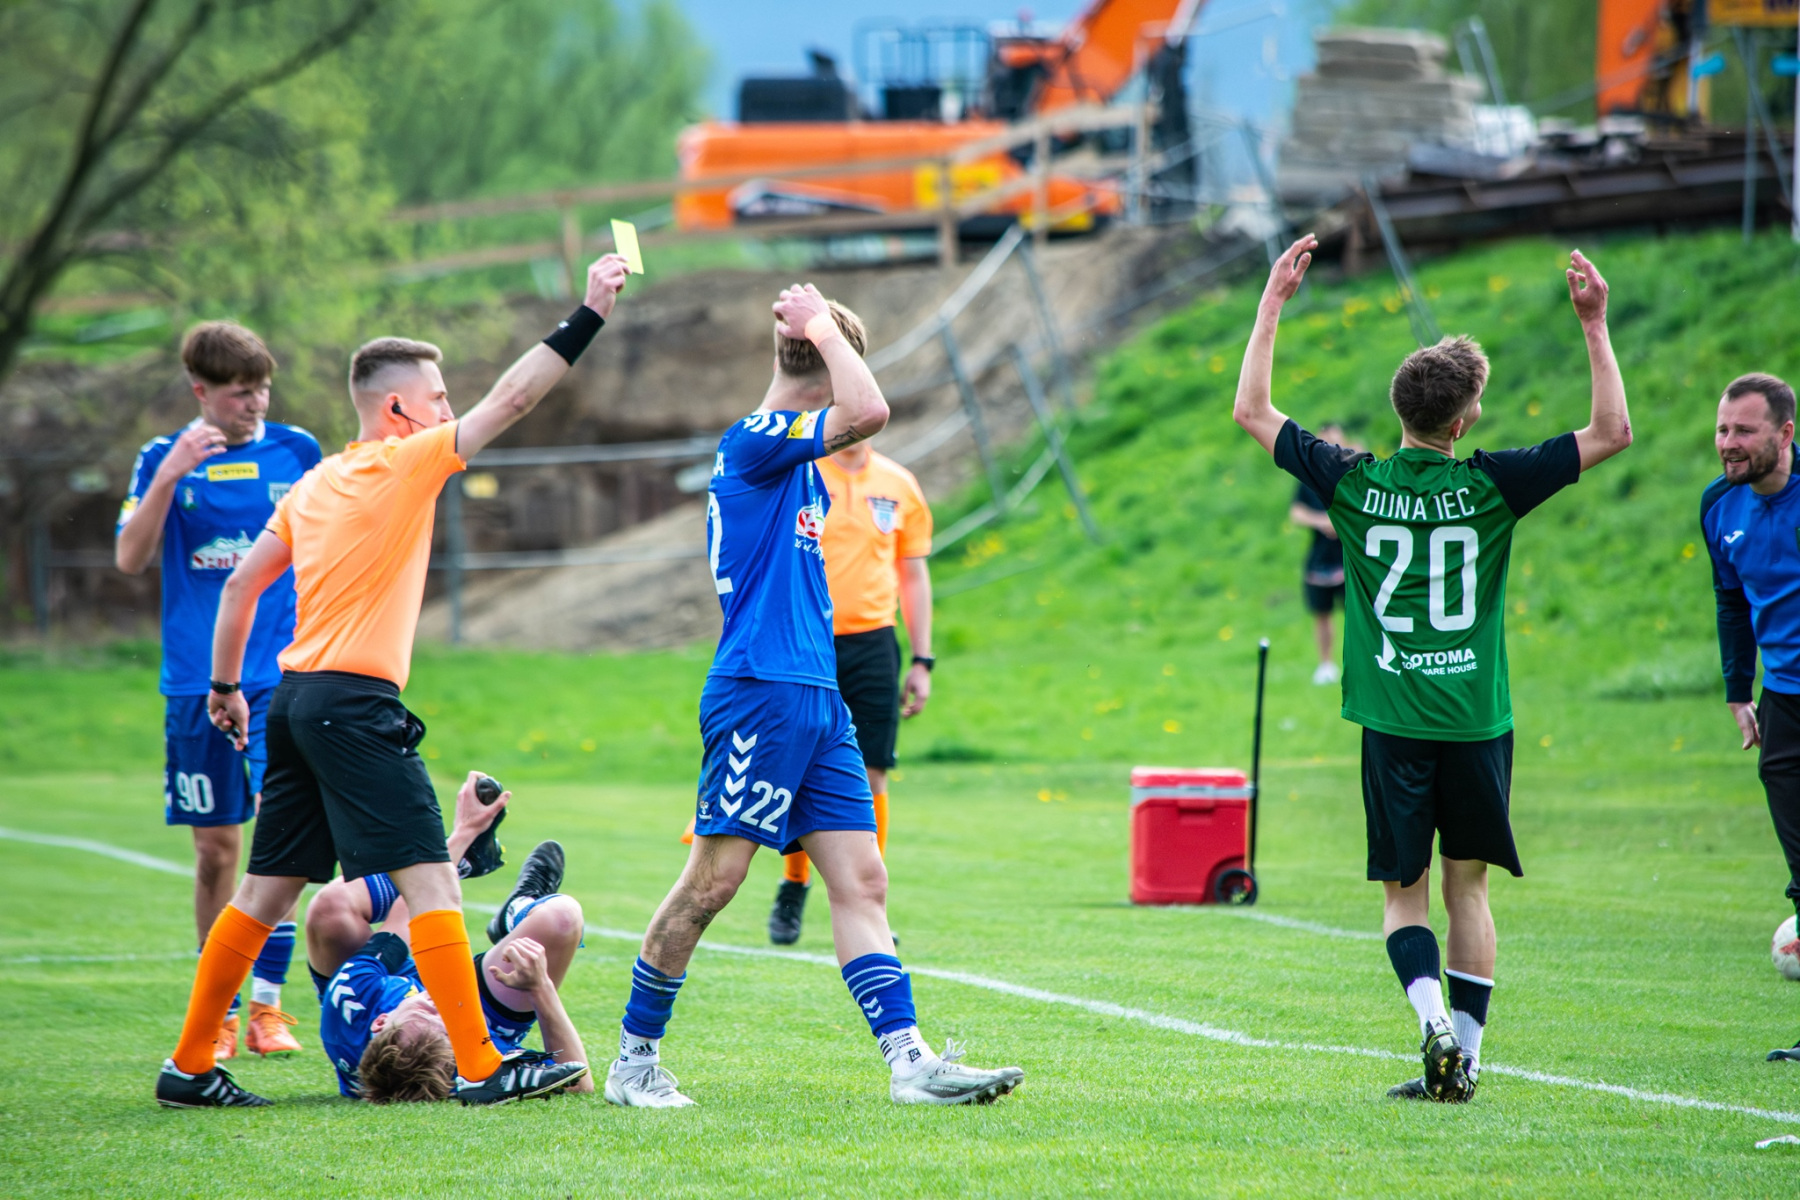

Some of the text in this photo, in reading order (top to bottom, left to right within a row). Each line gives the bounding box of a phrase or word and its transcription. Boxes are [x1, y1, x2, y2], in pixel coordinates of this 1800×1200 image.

[1365, 525, 1479, 633] 20
[1401, 648, 1476, 667] OTOMA
[1447, 662, 1478, 675] HOUSE
[177, 771, 215, 814] 90
[739, 780, 793, 834] 22
